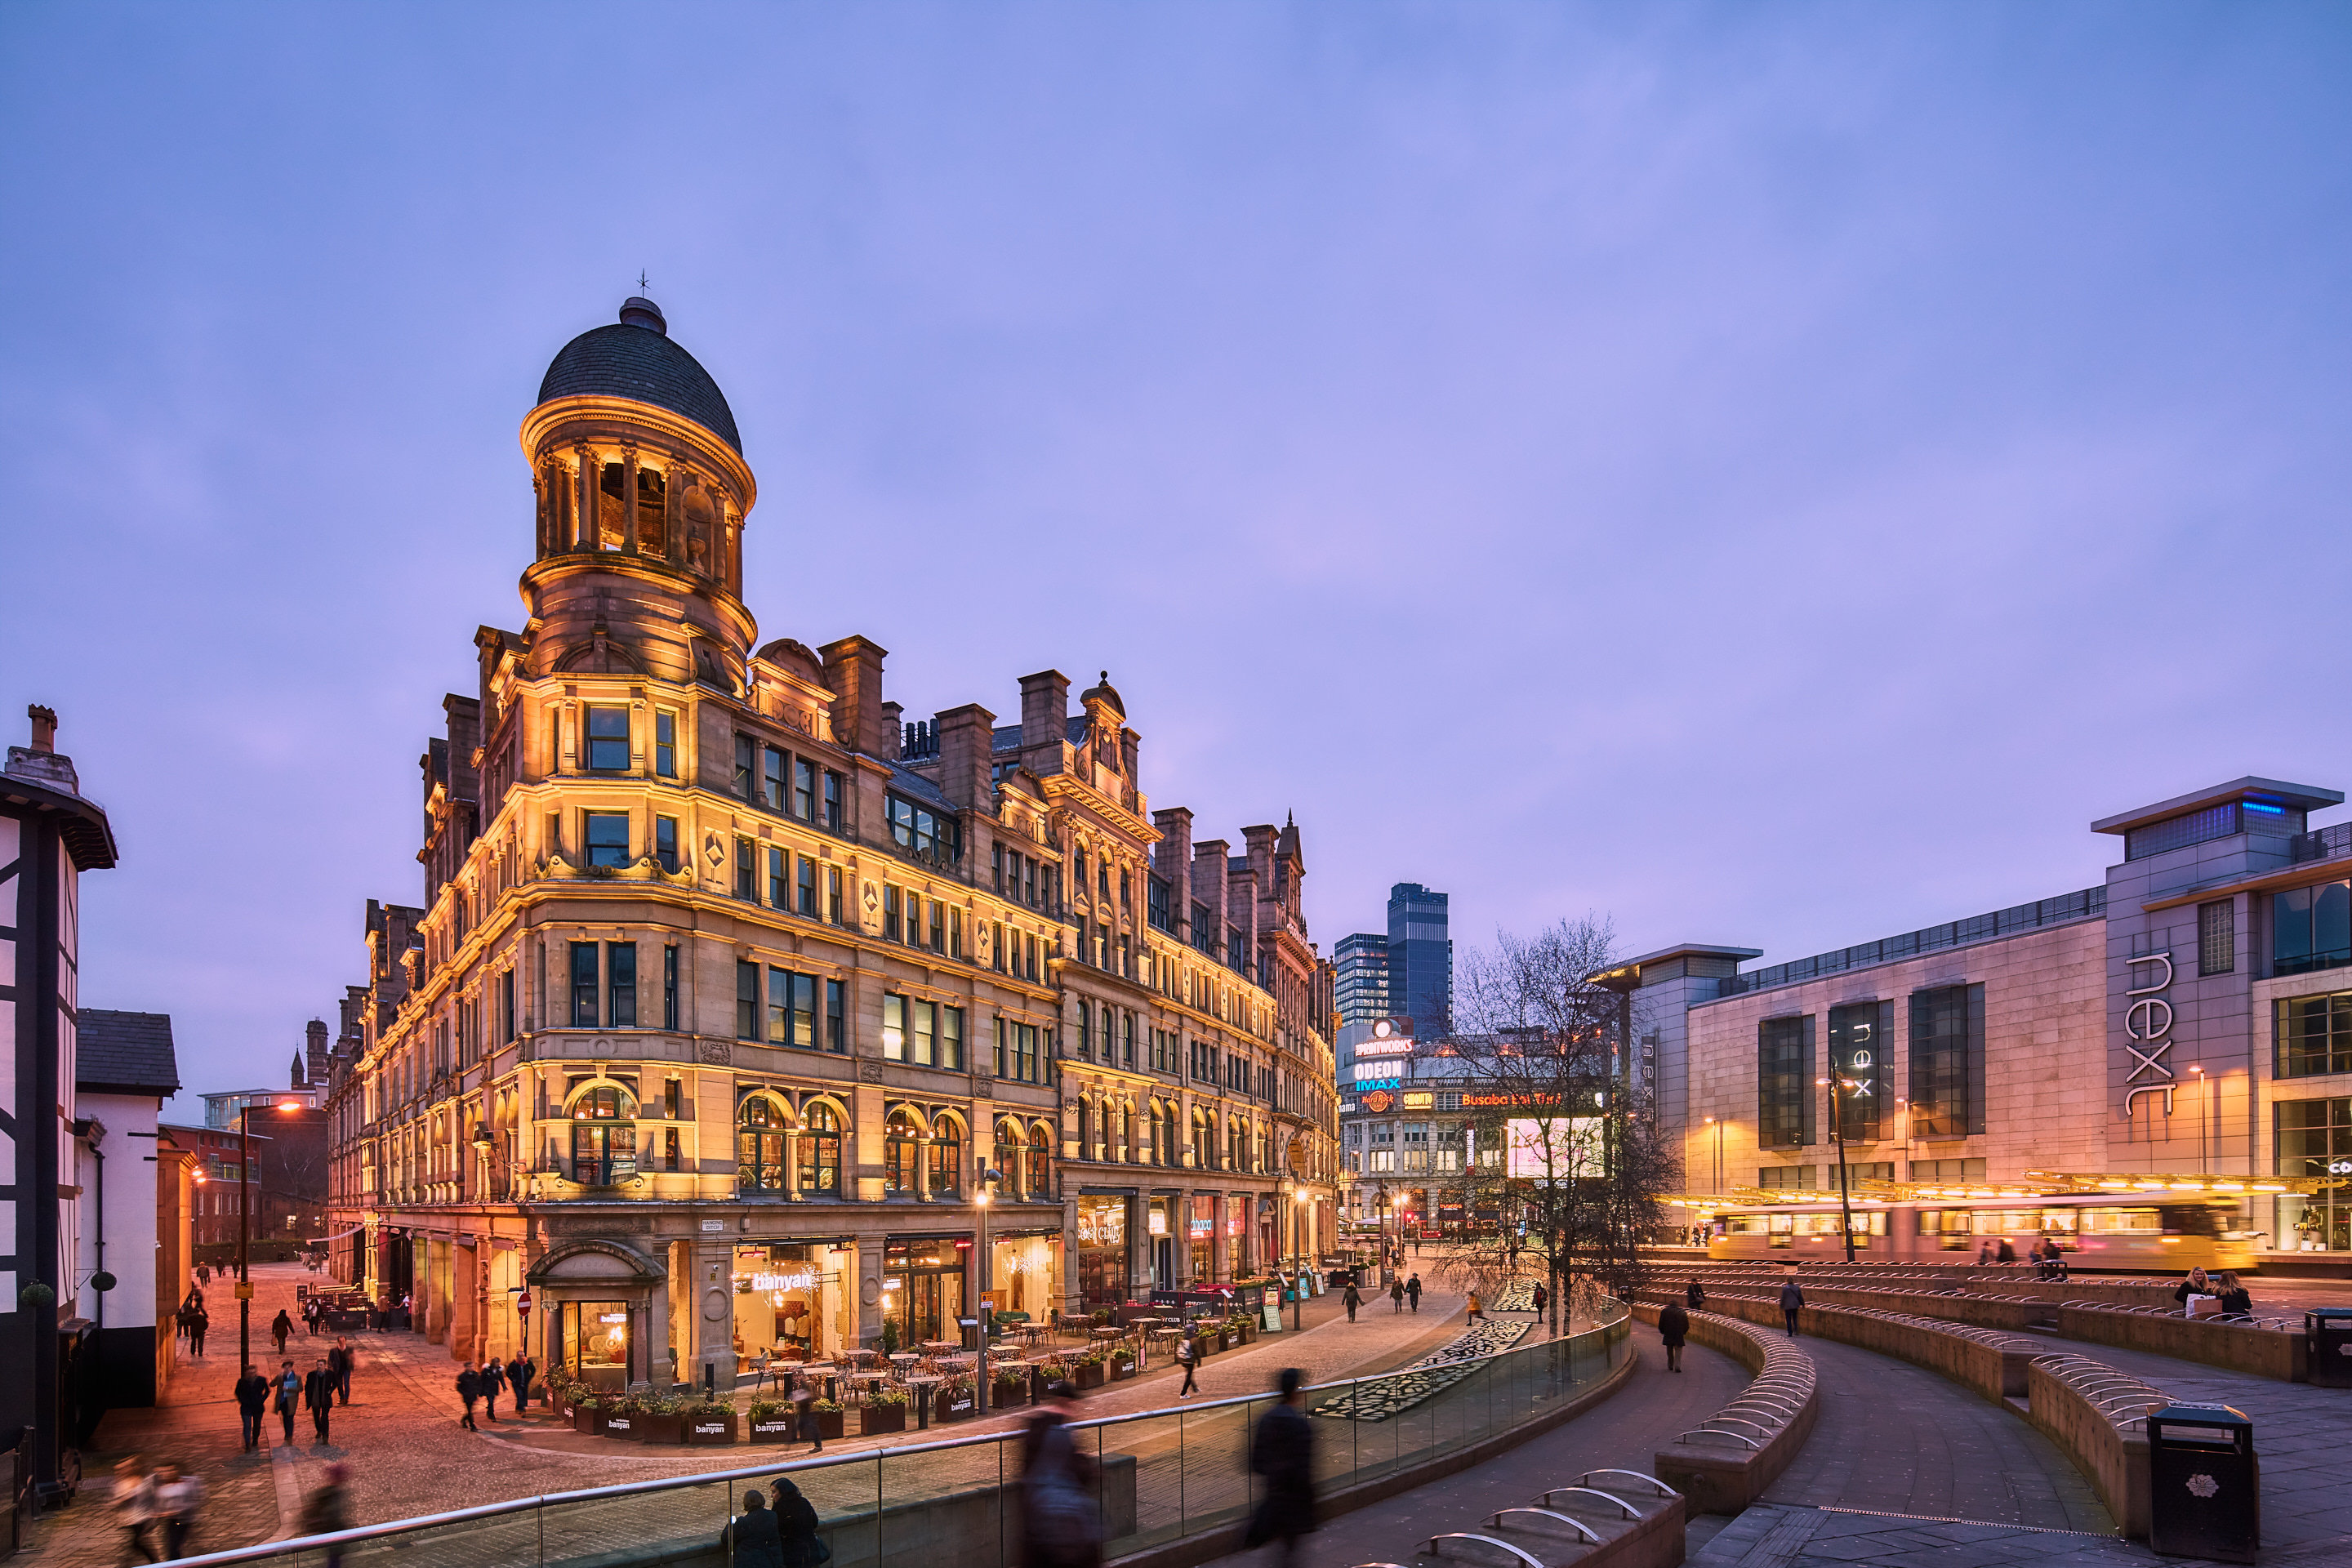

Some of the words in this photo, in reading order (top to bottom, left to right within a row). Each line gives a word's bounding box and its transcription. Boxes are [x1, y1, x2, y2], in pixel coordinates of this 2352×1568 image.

[2125, 951, 2176, 1116] next
[1360, 1039, 1413, 1055] PRINTWORKS
[1355, 1061, 1402, 1080] ODEON
[1853, 1023, 1872, 1120] next
[1356, 1078, 1401, 1091] IMAX
[1362, 1095, 1378, 1104] Hard
[1378, 1094, 1394, 1104] Rock
[1462, 1094, 1508, 1106] Busaba
[1191, 1217, 1212, 1231] ahaca
[754, 1273, 813, 1293] banyan
[951, 1401, 971, 1411] banyan
[608, 1420, 630, 1430] banyan
[695, 1425, 724, 1435] banyan
[755, 1424, 786, 1433] banyan
